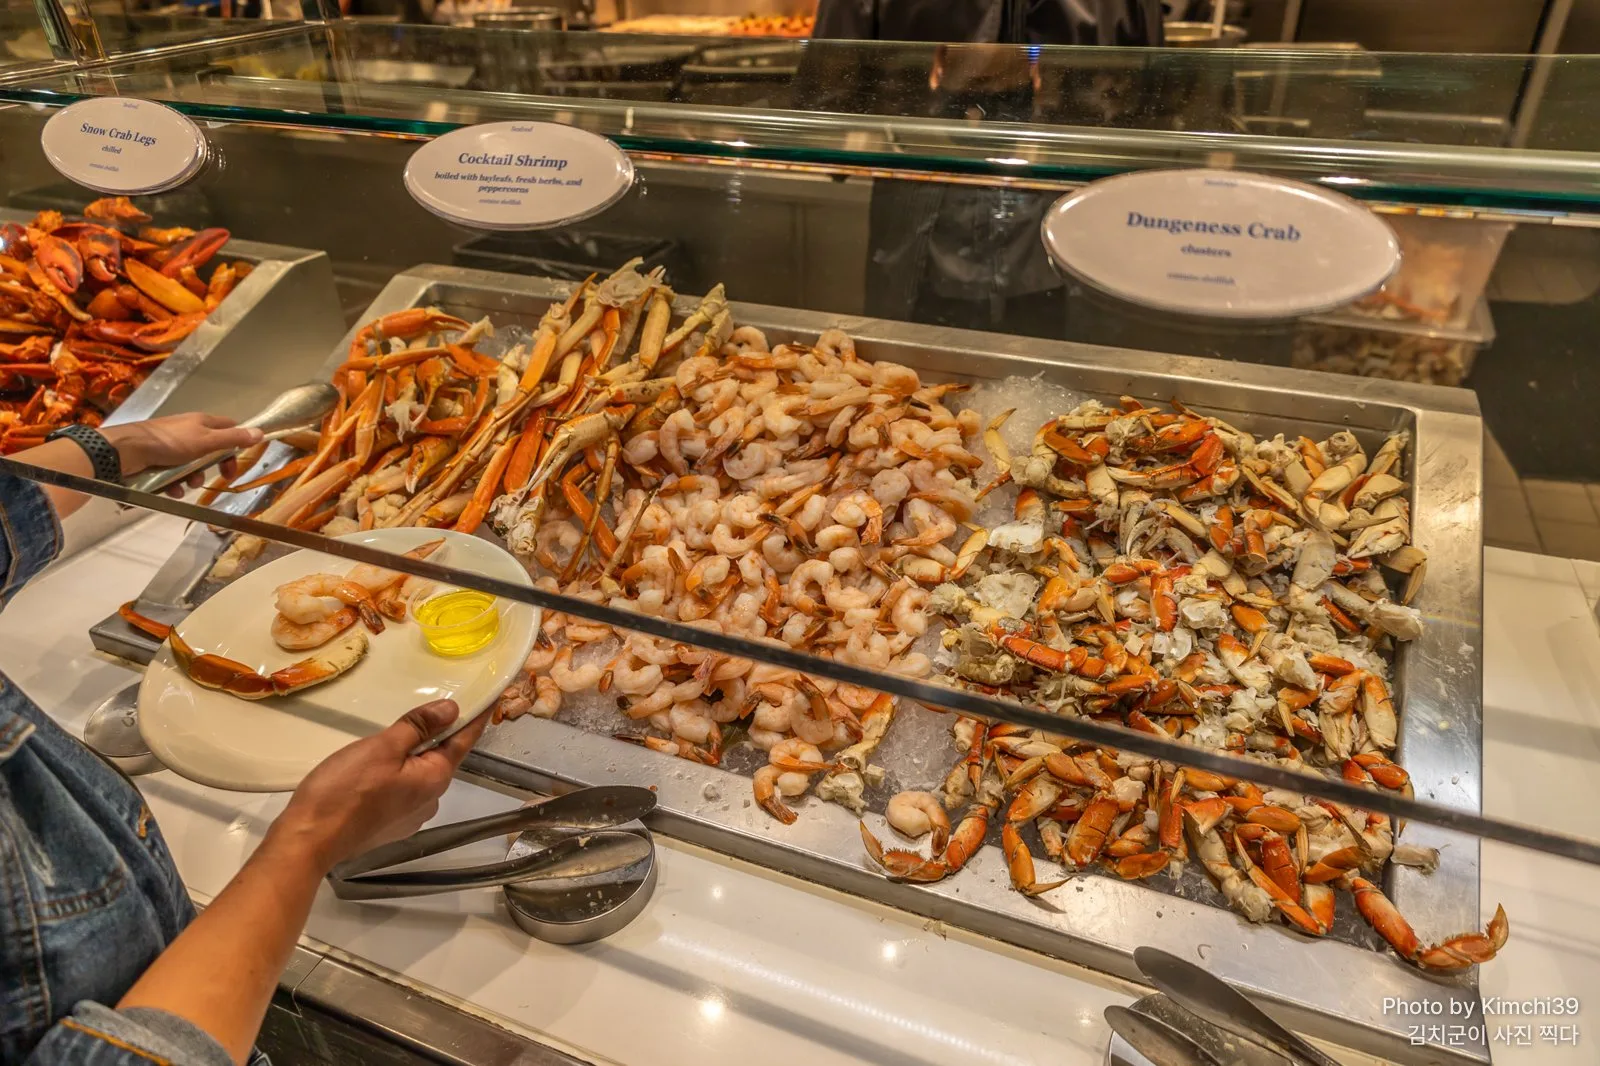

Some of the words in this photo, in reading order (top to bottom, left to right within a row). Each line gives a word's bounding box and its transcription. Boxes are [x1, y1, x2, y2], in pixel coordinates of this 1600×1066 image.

[80, 122, 107, 136] Snow
[109, 127, 132, 141] Crab
[133, 132, 157, 146] Legs
[101, 144, 122, 154] chilled
[458, 152, 513, 166] Cocktail
[515, 155, 568, 170] Shrimp
[434, 171, 459, 180] boiled
[460, 173, 478, 181] with
[515, 175, 537, 184] fresh
[538, 176, 563, 186] herbs,
[565, 178, 583, 186] and
[478, 185, 529, 194] peppercorns
[1126, 211, 1242, 236] Dungeness
[1247, 222, 1302, 242] Crab
[1180, 243, 1232, 257] clusters
